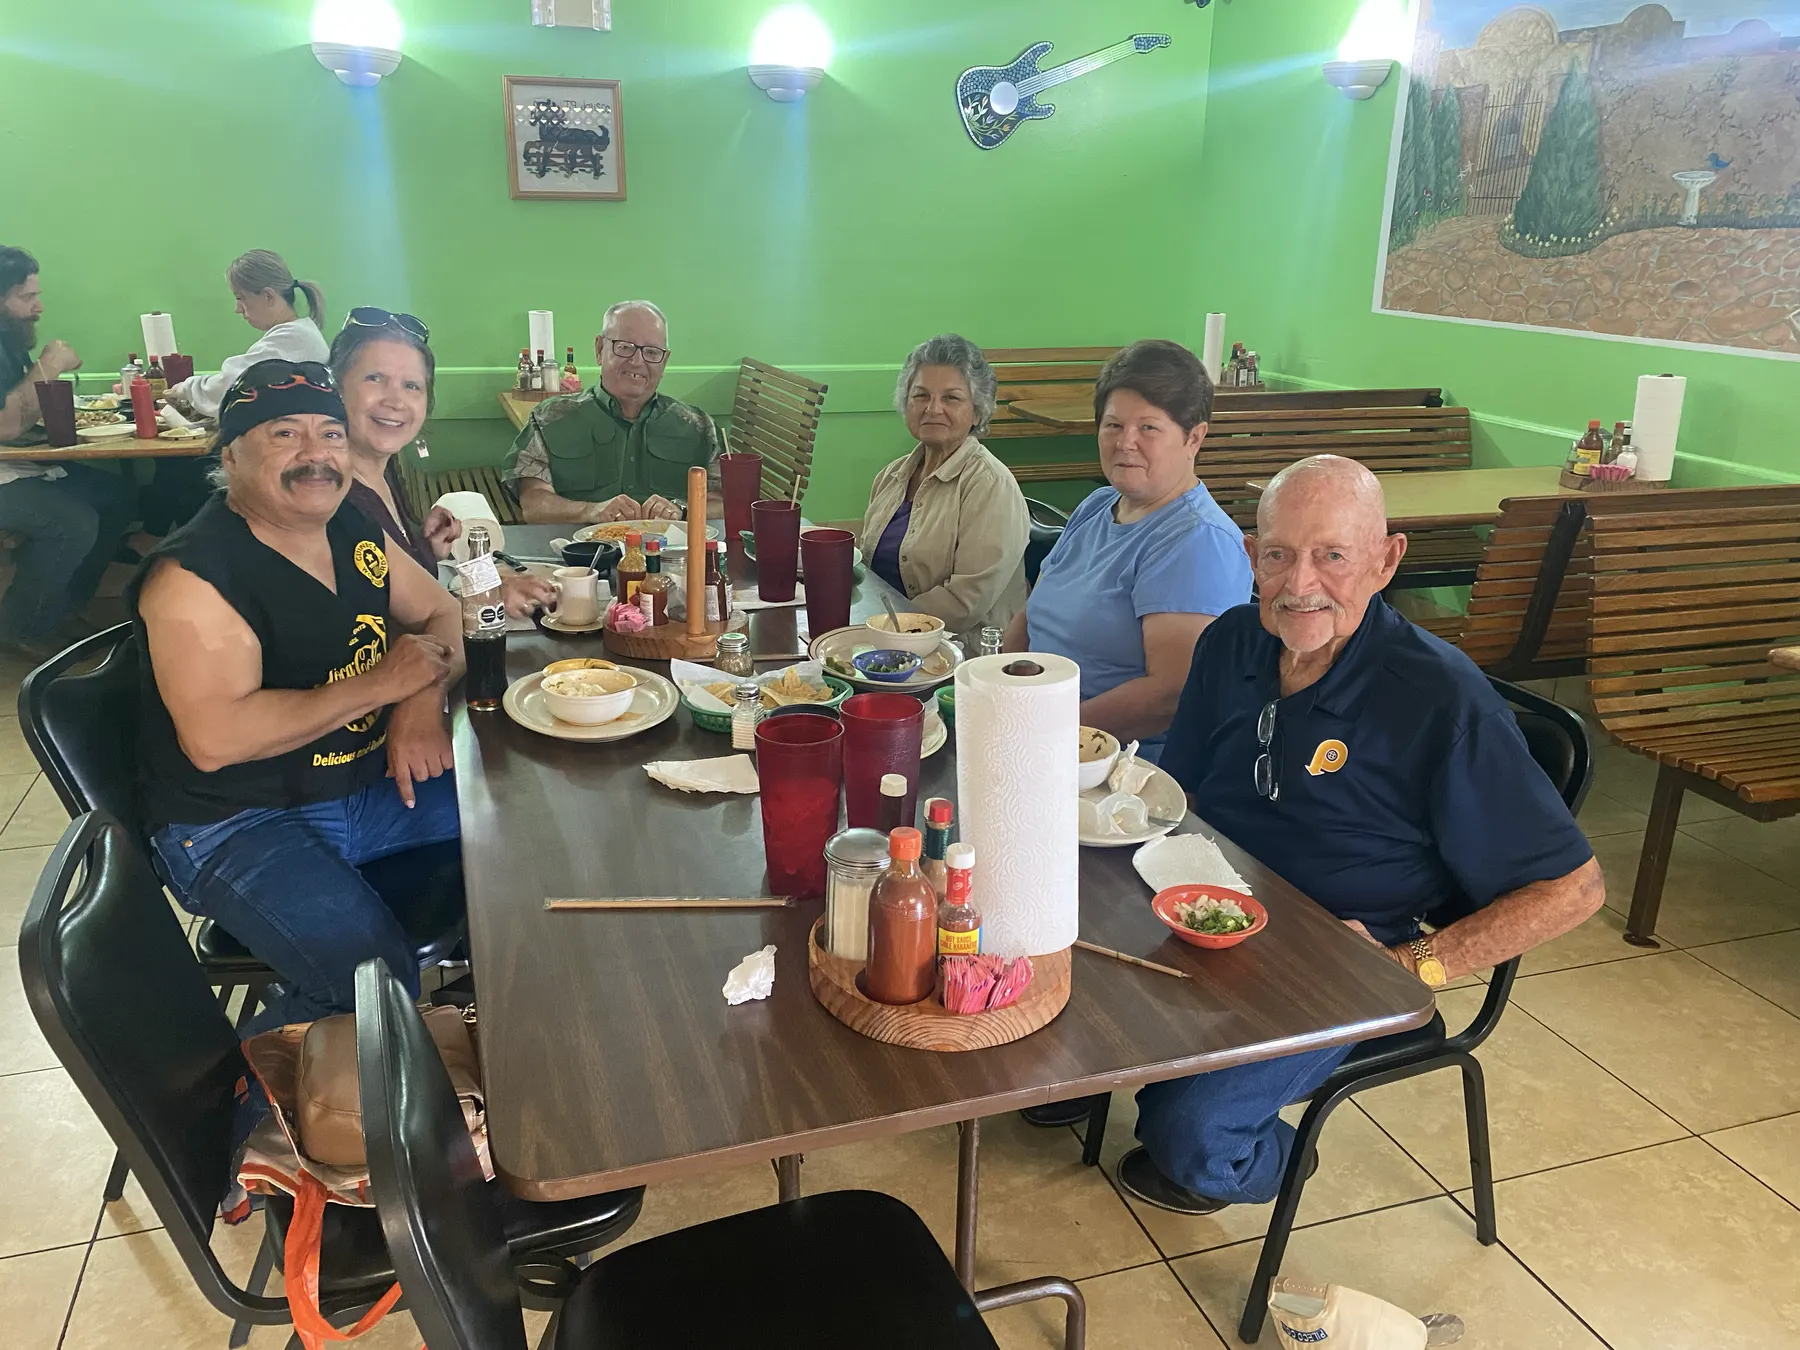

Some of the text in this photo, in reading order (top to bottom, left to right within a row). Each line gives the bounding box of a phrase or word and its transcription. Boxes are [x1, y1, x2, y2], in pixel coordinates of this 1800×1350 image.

[312, 751, 356, 767] Delicious
[956, 935, 972, 944] SAUCE
[1297, 1329, 1326, 1342] PILECO
